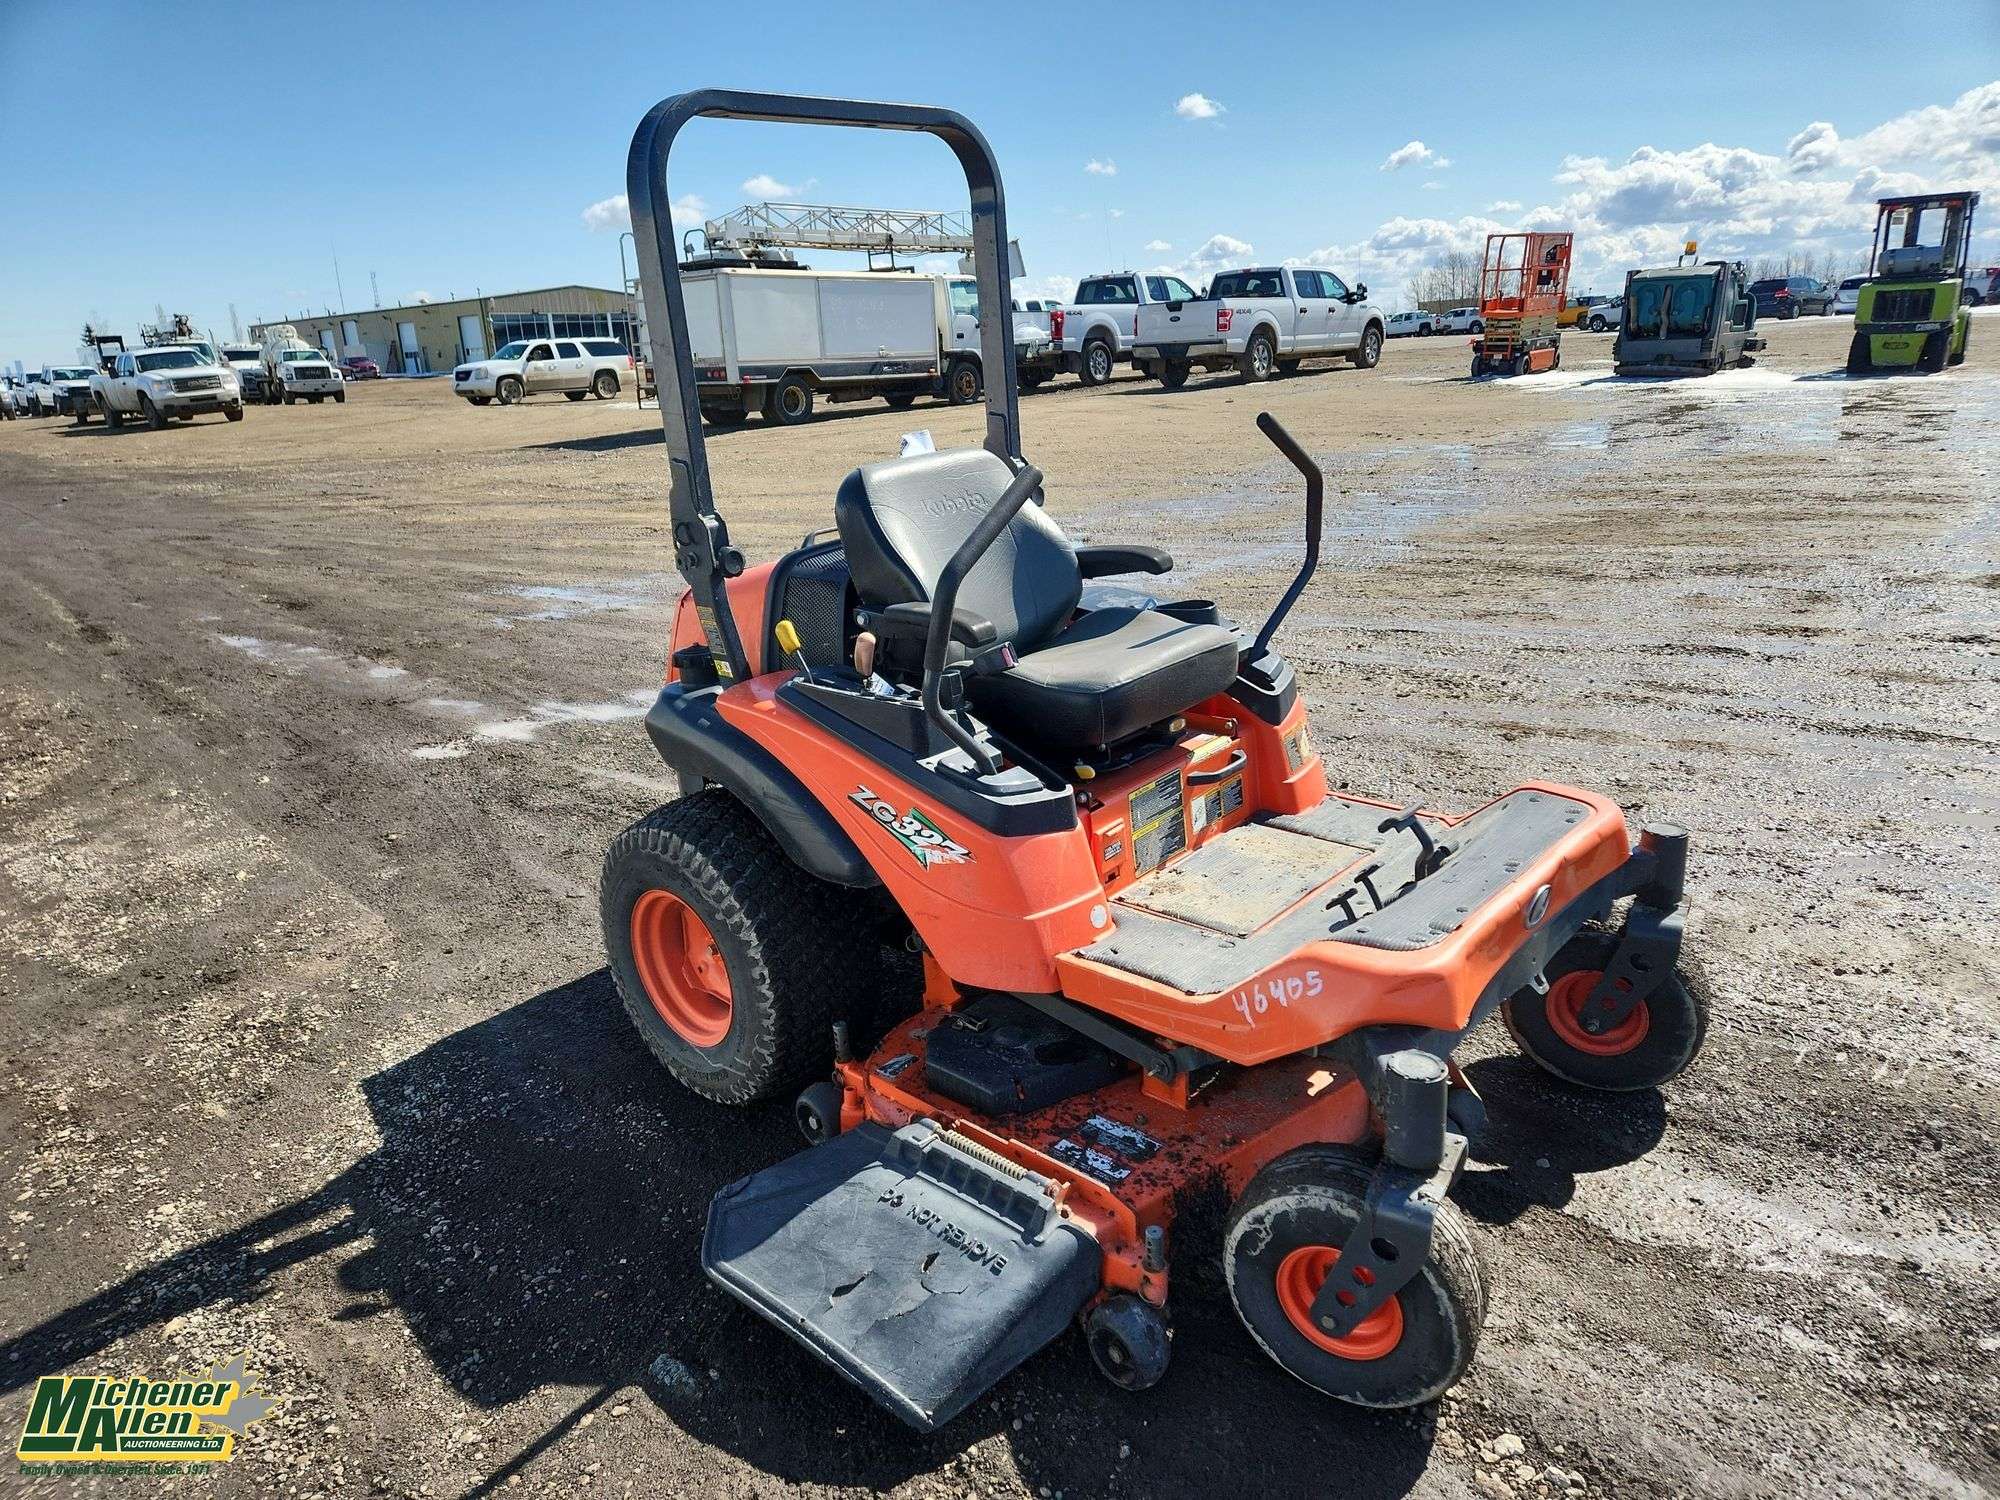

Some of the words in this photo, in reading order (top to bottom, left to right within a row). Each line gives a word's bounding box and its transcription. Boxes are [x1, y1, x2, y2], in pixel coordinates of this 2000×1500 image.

[1231, 970, 1323, 1029] 46405
[877, 1187, 905, 1208] DO
[906, 1204, 943, 1231] NOT
[937, 1221, 1008, 1276] REMOVE
